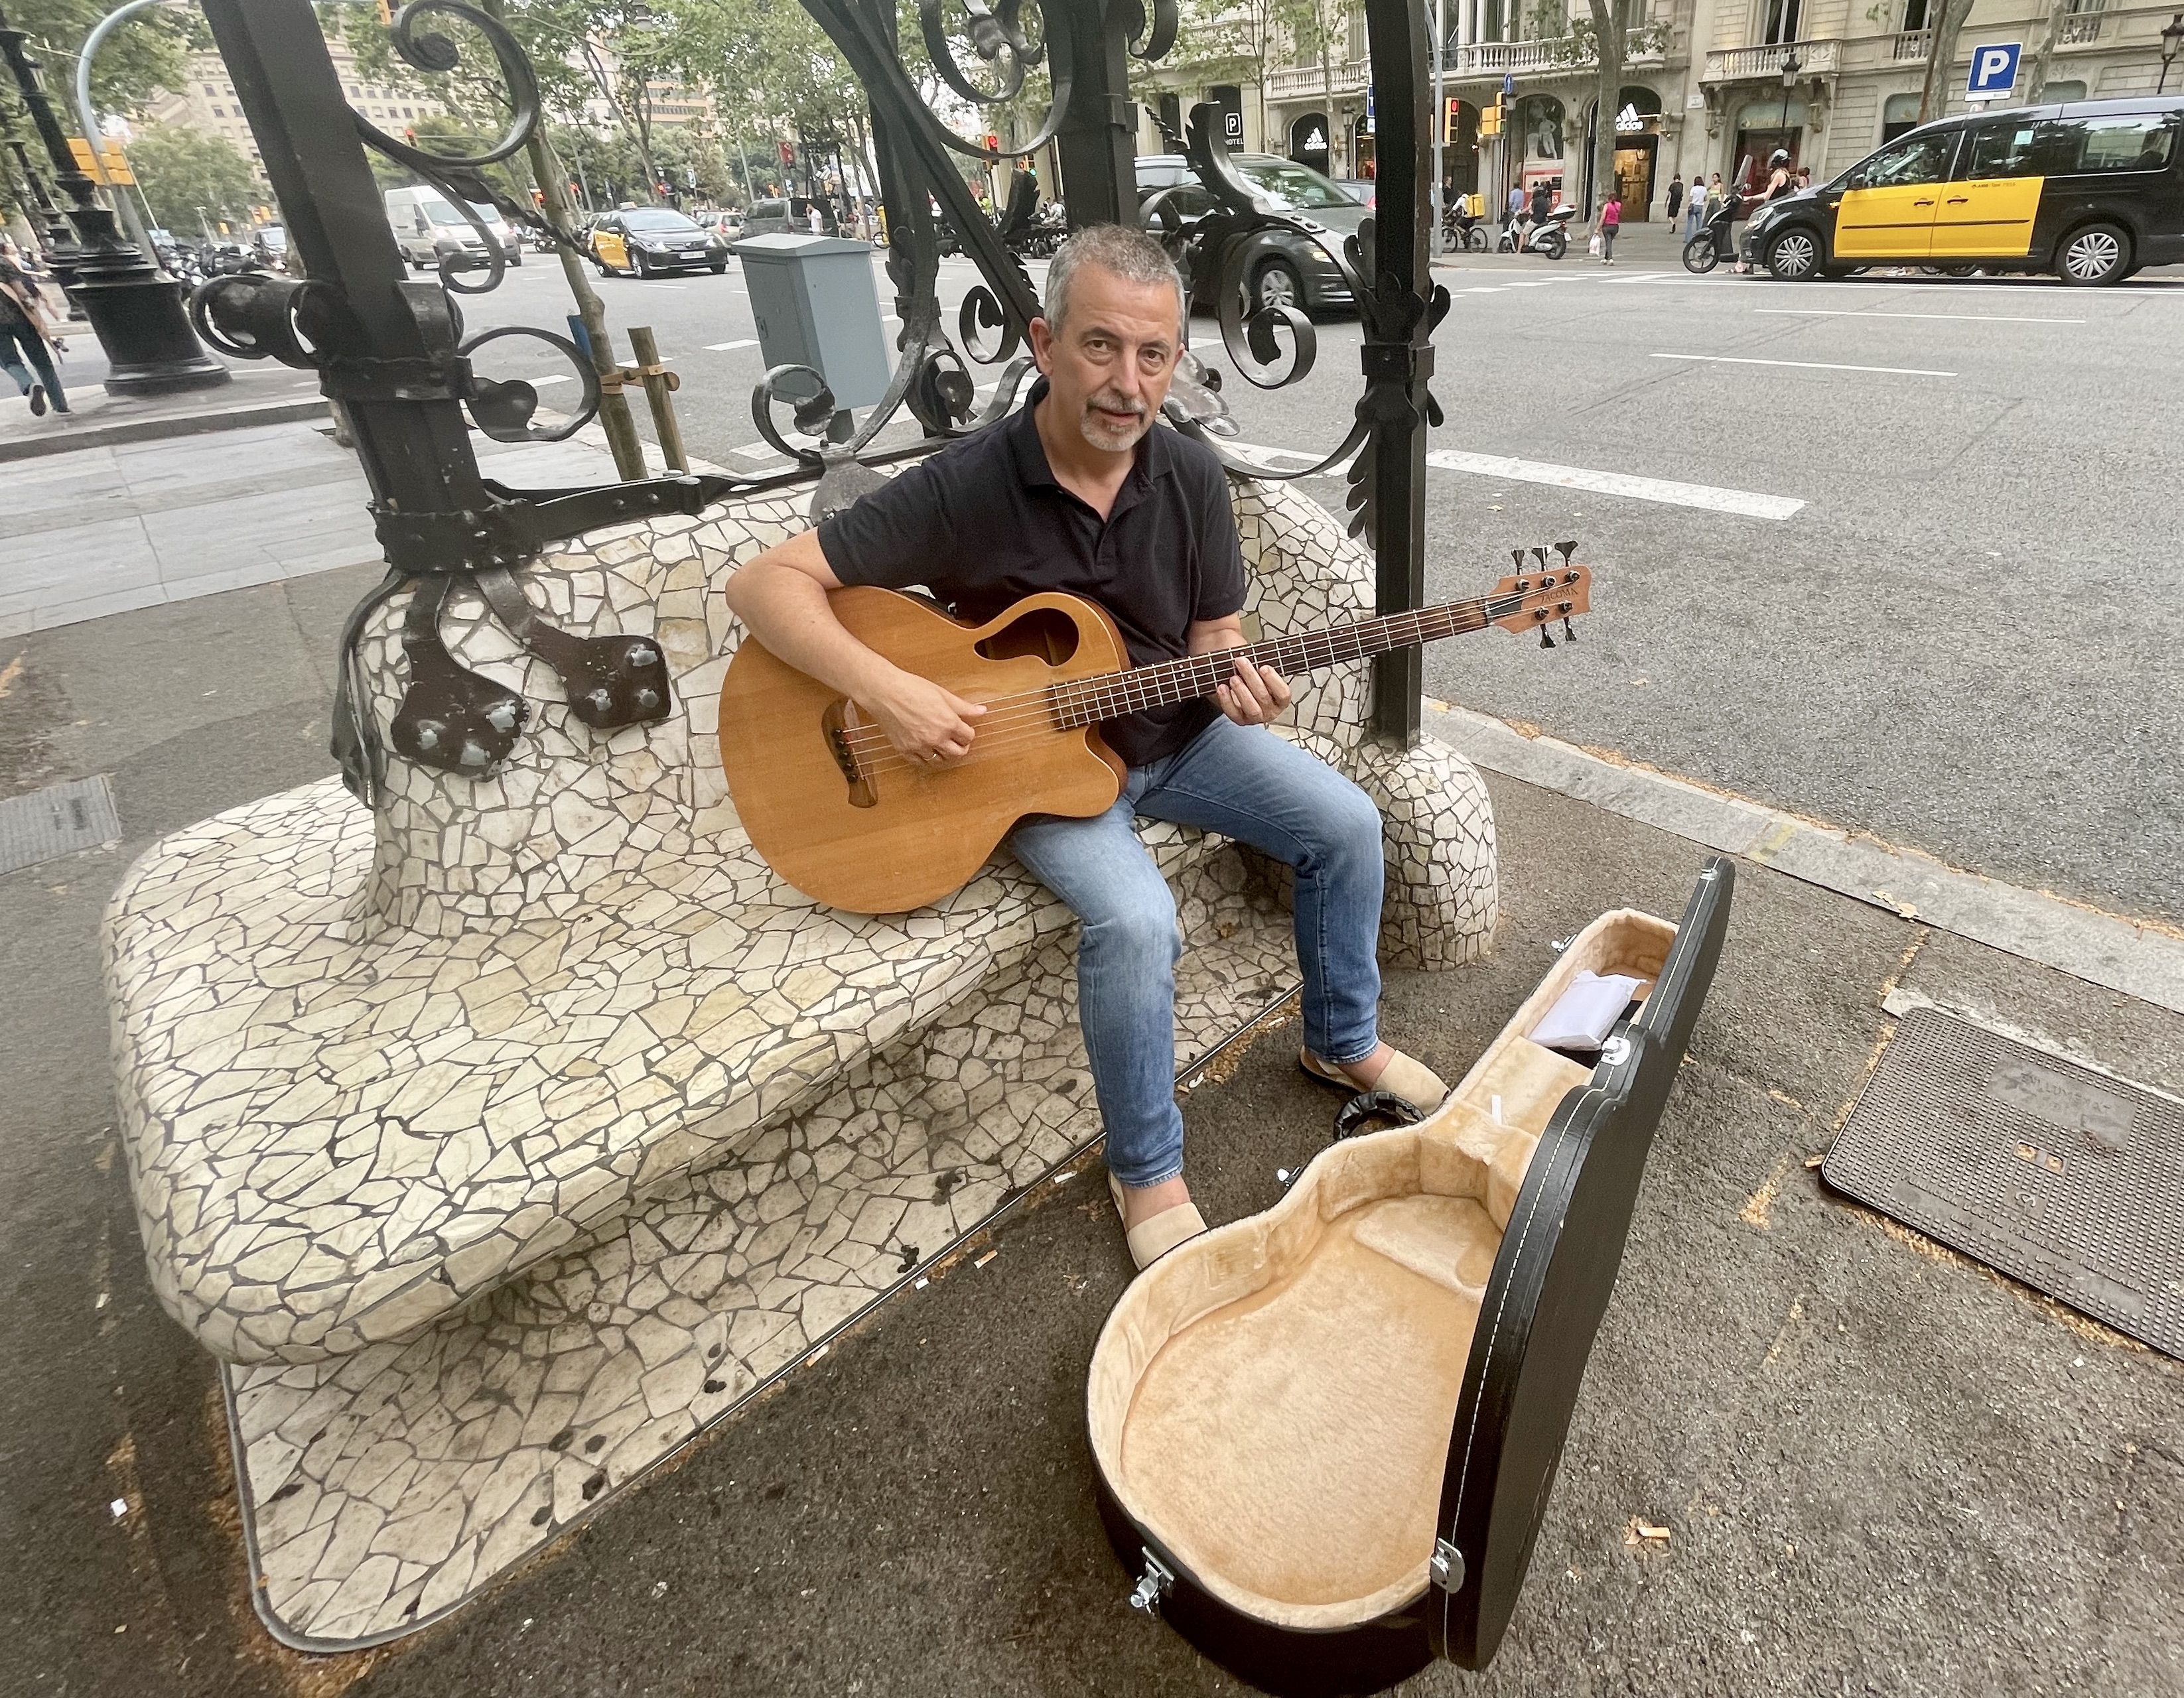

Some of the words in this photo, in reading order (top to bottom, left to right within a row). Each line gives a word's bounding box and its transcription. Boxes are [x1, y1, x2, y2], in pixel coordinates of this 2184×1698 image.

[1978, 50, 2010, 86] P
[1229, 117, 1237, 131] P
[1615, 121, 1643, 131] didas
[1304, 142, 1328, 151] adidas
[1540, 588, 1578, 604] TACOMA
